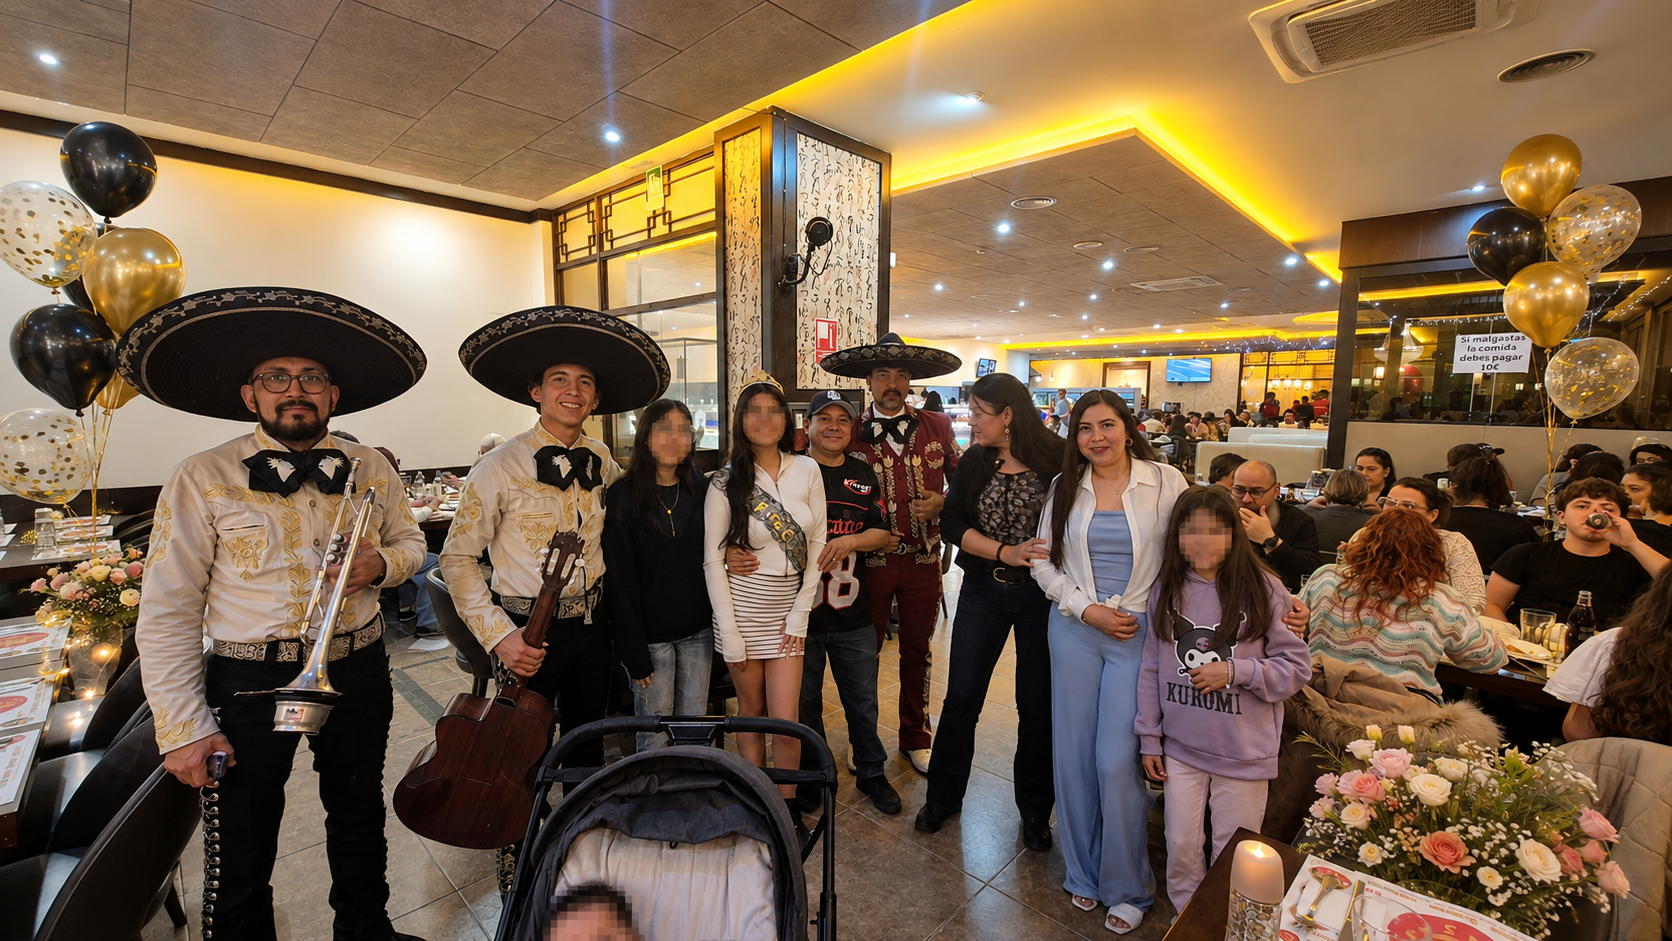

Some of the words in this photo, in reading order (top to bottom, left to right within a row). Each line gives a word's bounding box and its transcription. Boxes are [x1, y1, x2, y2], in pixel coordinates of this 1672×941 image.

[1472, 335, 1526, 344] malgastas
[1478, 344, 1517, 352] comida
[1459, 354, 1490, 362] debes
[1492, 354, 1524, 363] pagar
[1166, 681, 1242, 715] KUROMI
